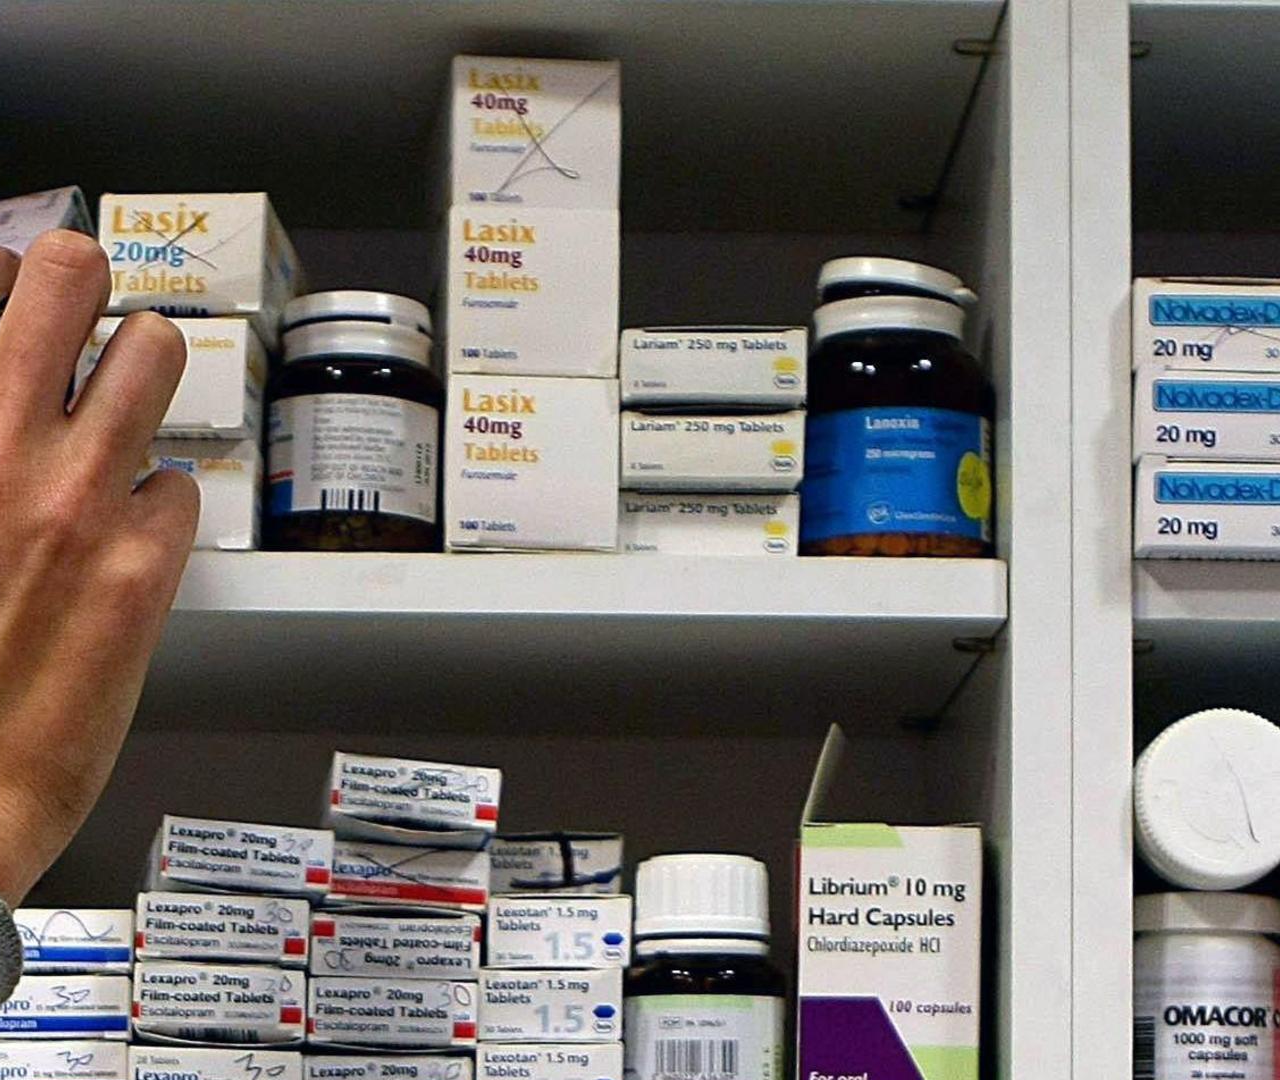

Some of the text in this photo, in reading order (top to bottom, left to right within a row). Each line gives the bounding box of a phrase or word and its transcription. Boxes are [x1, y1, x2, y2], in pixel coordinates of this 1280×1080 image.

[112, 205, 209, 234] Lasix
[112, 242, 185, 267] 20mg
[112, 273, 207, 293] Tablets
[688, 339, 712, 351] 250
[716, 341, 737, 354] mg
[741, 339, 787, 351] Tablets
[463, 389, 536, 414] Lasix
[464, 417, 522, 438] 40mg
[464, 443, 539, 463] Tablets
[460, 520, 516, 533] 100 Tablets
[1158, 518, 1183, 537] 20
[1187, 521, 1218, 540] mg
[905, 878, 926, 897] 10
[932, 881, 966, 903] mg
[146, 901, 254, 919] Lexapro 20mg
[555, 906, 573, 920] 1.5
[576, 908, 599, 923] mg
[808, 908, 955, 929] Hard Capsules
[145, 917, 278, 936] Film-coated Tablets
[496, 919, 541, 933] Tablets
[543, 932, 595, 962] 1.5
[807, 935, 914, 955] Chlordiazepoxide
[889, 1001, 972, 1017] 100 capsules
[1164, 1005, 1266, 1029] OMACOR
[1173, 1033, 1258, 1050] 1000 mg soft
[1188, 1048, 1248, 1063] capsules
